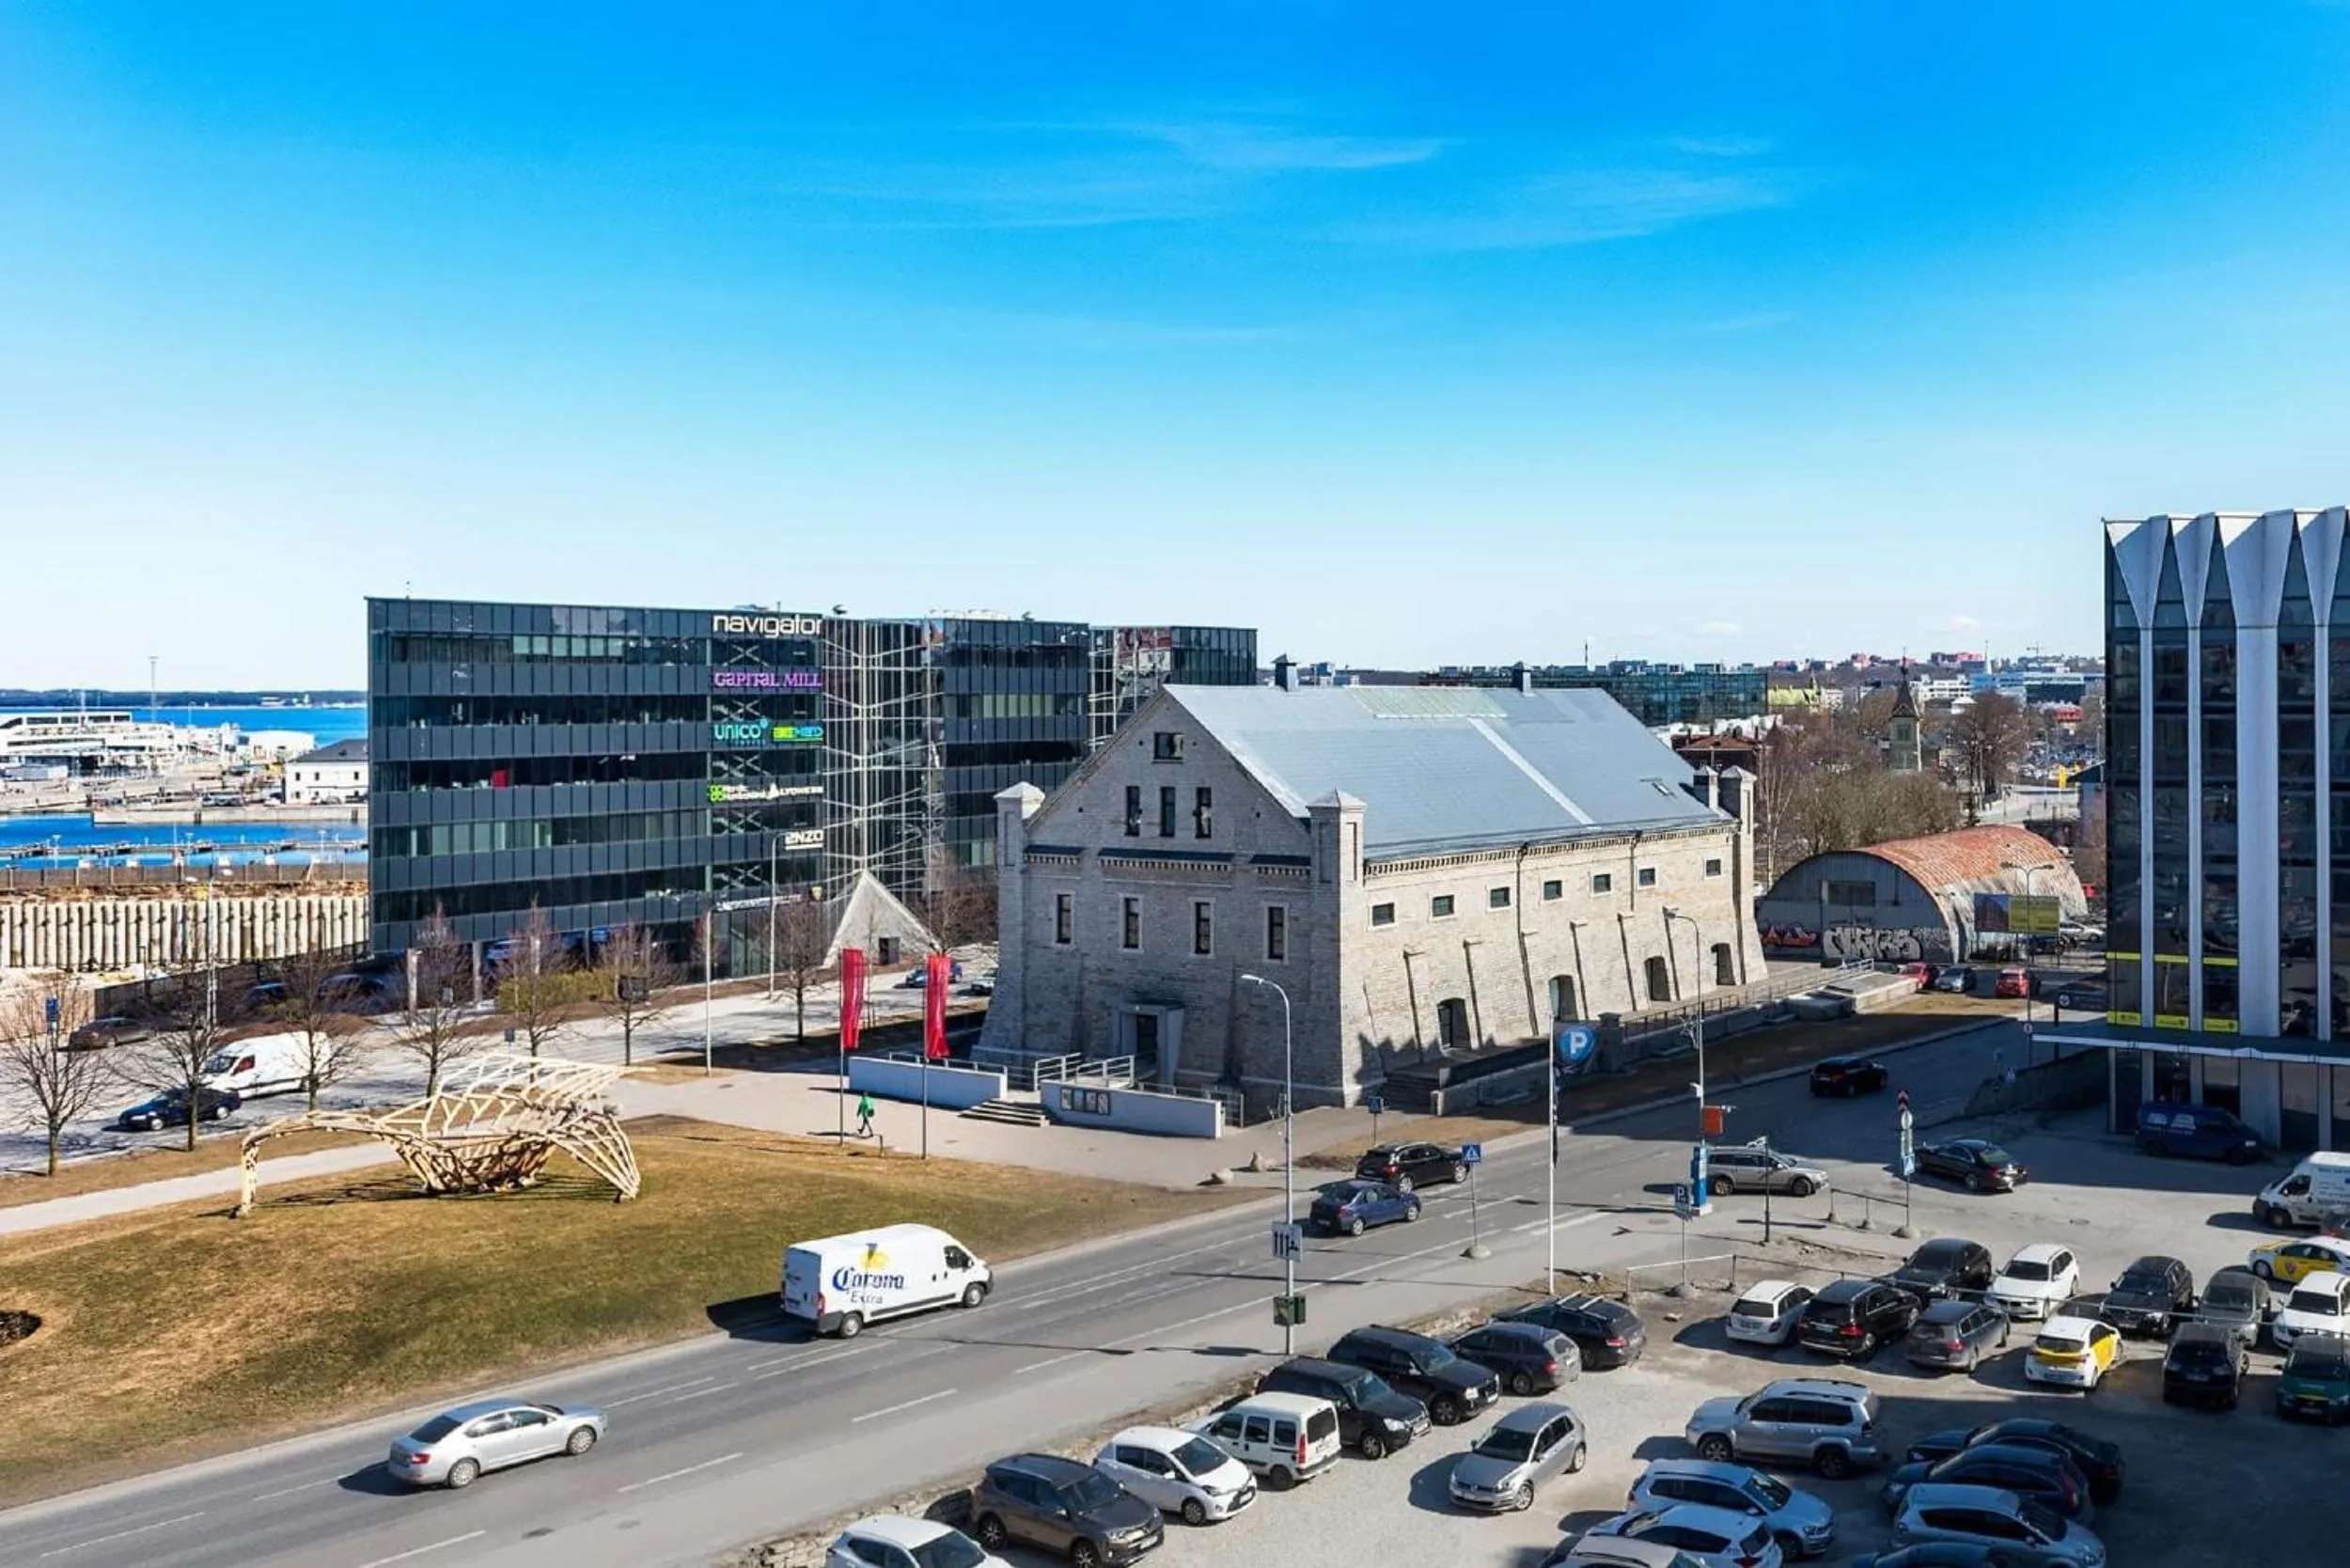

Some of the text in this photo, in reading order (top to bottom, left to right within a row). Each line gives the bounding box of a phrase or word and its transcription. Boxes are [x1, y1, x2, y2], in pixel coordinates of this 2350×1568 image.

[713, 614, 823, 638] navigator
[782, 672, 823, 687] MILL
[1571, 1030, 1588, 1054] P
[832, 1266, 904, 1291] Corona
